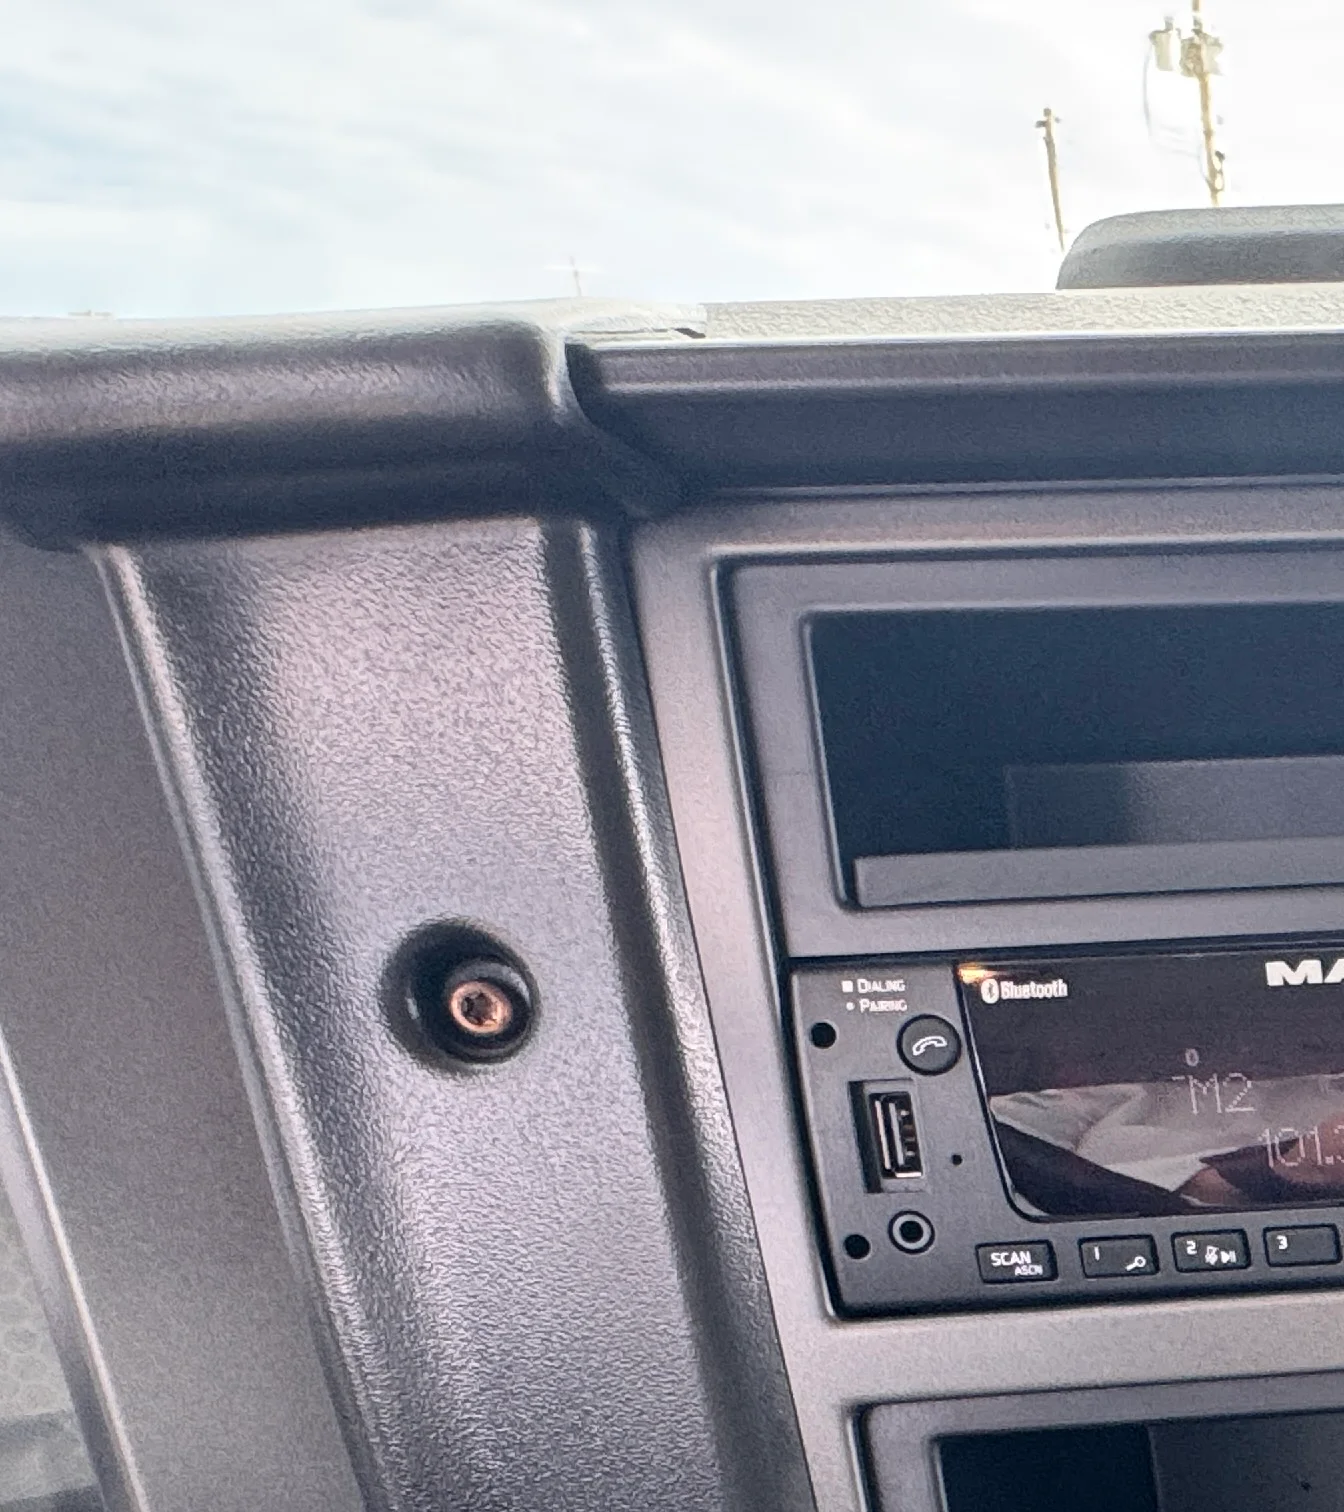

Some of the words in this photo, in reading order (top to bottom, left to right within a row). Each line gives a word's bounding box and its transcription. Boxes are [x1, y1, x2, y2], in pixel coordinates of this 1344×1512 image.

[1000, 978, 1068, 1000] Bluetooth
[1186, 1240, 1197, 1255] 2
[1276, 1235, 1288, 1250] 3
[990, 1250, 1032, 1268] SCAN
[1093, 1246, 1100, 1261] 1
